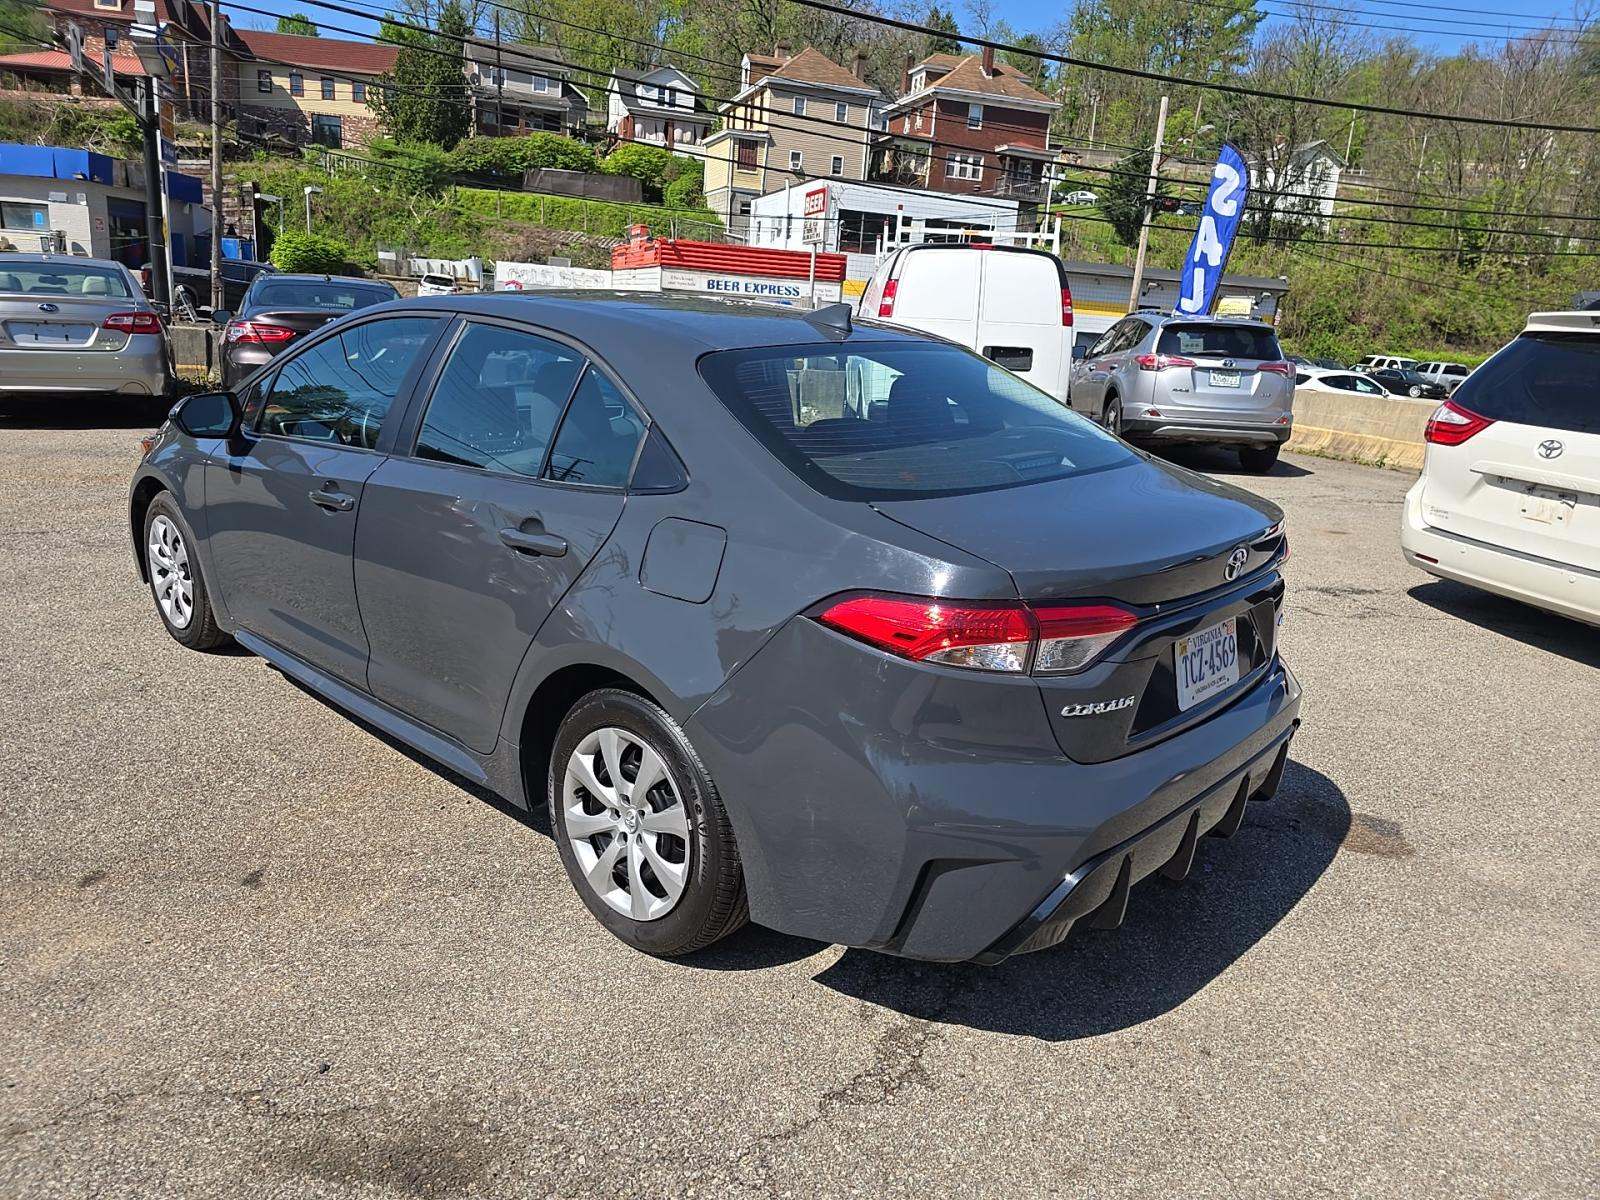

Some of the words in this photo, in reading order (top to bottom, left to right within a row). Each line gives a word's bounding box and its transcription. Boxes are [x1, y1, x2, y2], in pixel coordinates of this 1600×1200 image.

[804, 192, 825, 214] BEER
[707, 279, 740, 292] BEER
[744, 283, 800, 297] EXPRESS
[1192, 627, 1223, 648] VIRGINIA
[1060, 695, 1136, 717] COROLLA
